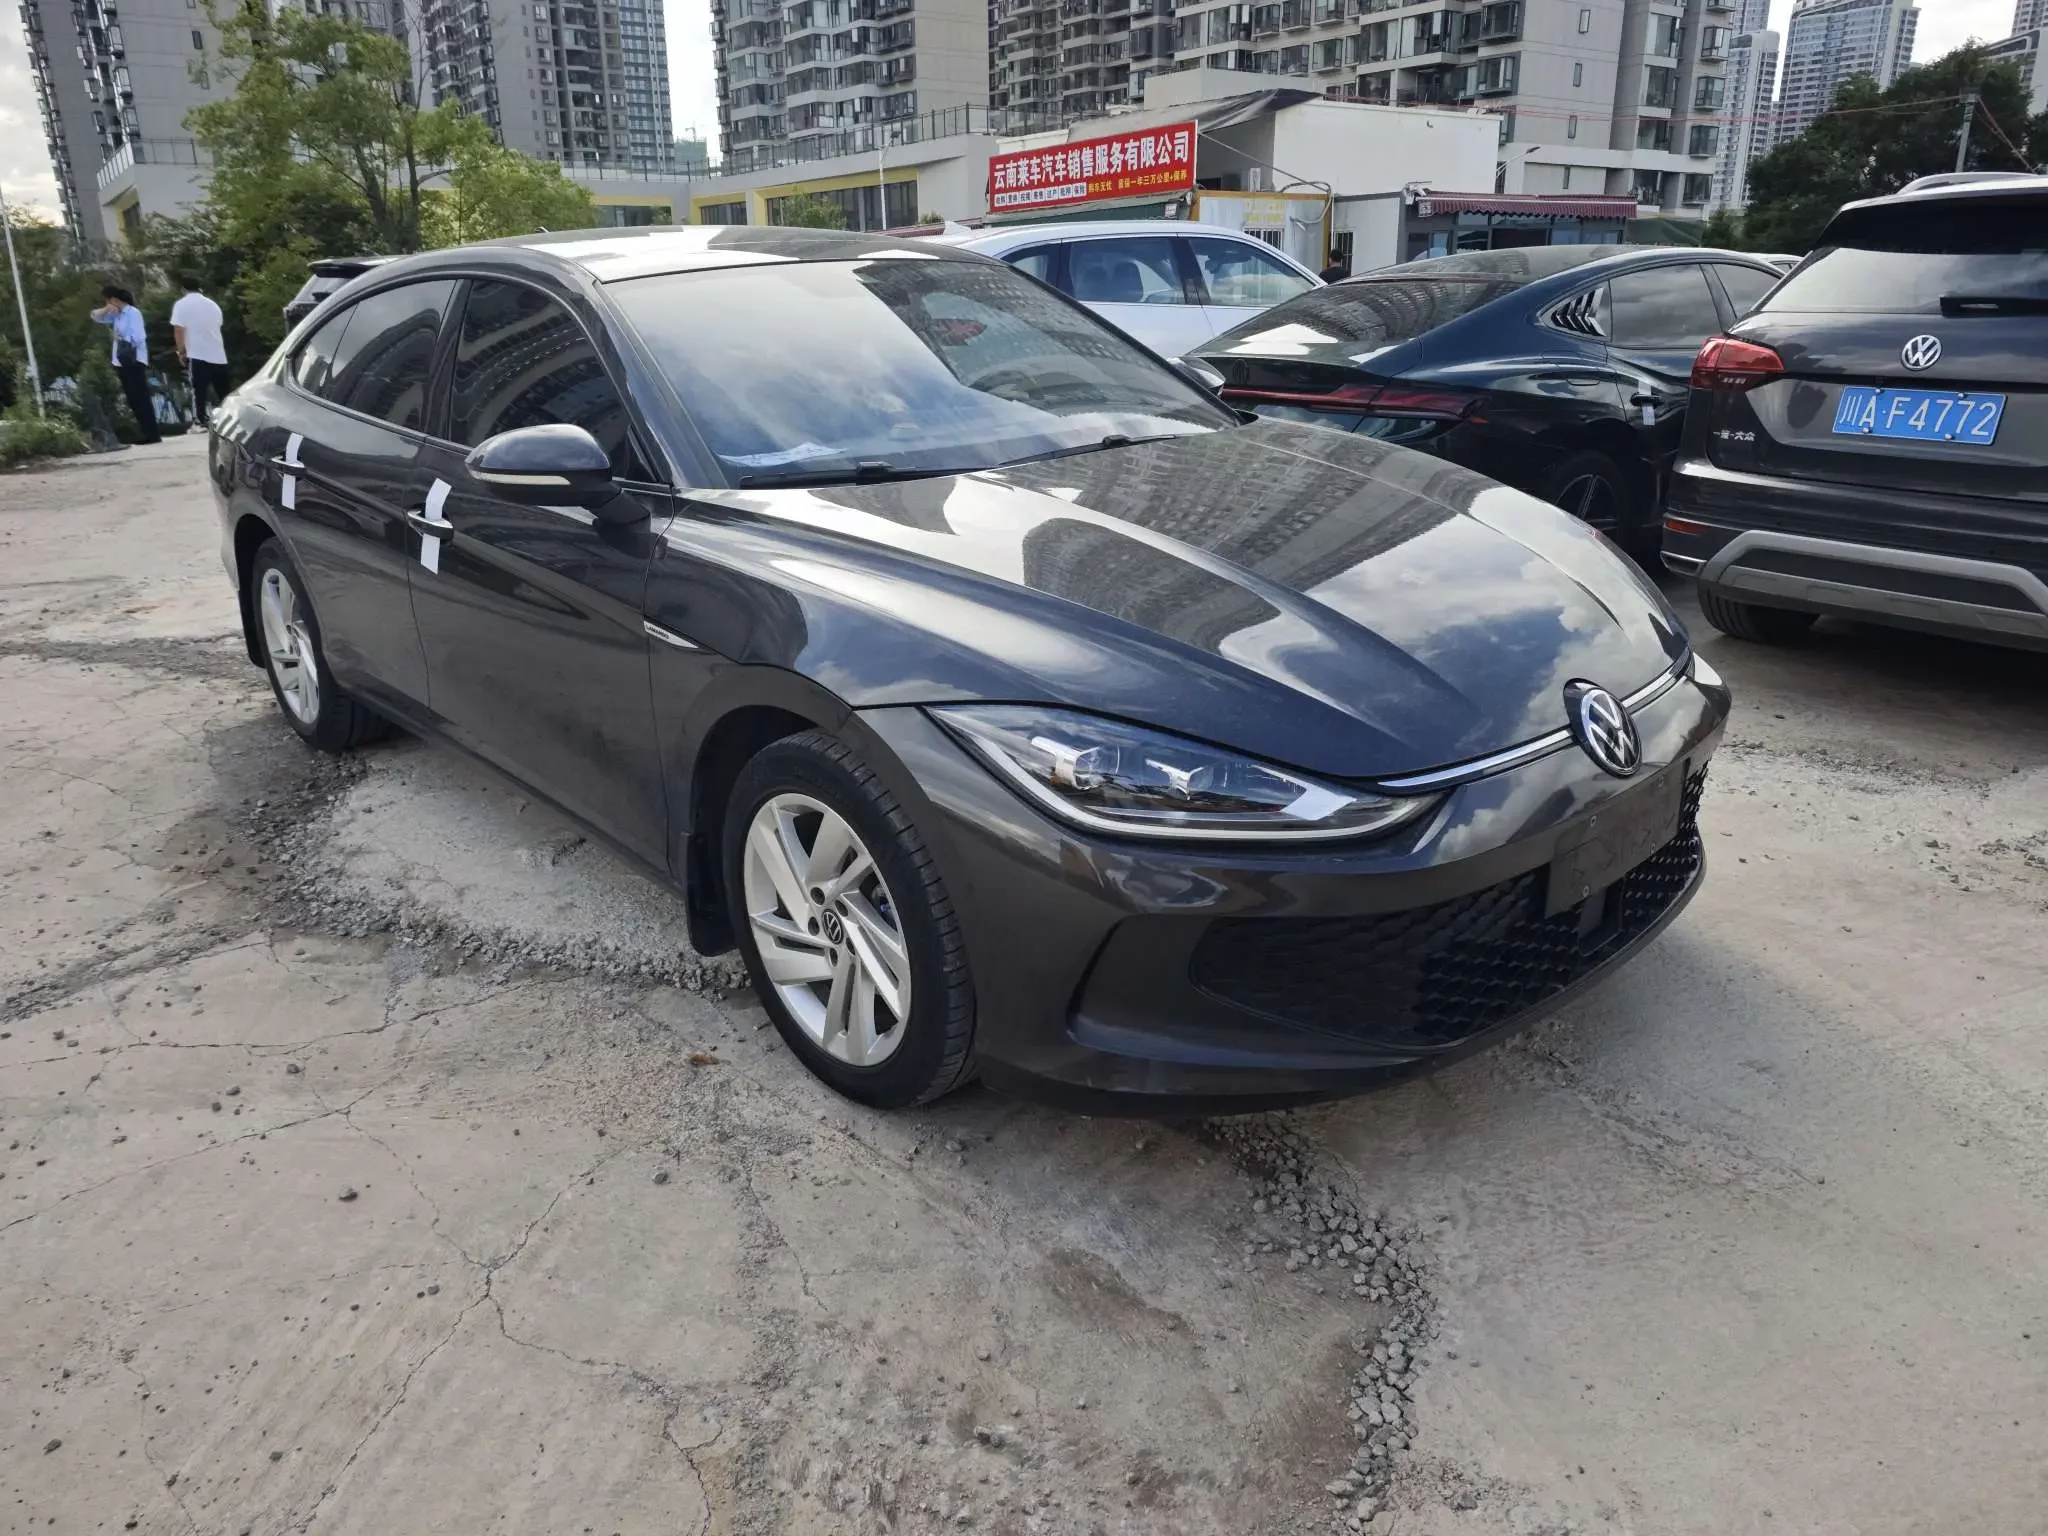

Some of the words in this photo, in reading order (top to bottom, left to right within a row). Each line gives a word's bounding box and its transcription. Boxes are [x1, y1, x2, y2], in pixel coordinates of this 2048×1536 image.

[994, 131, 1189, 189] 云南莱车汽车销售服务有限公司
